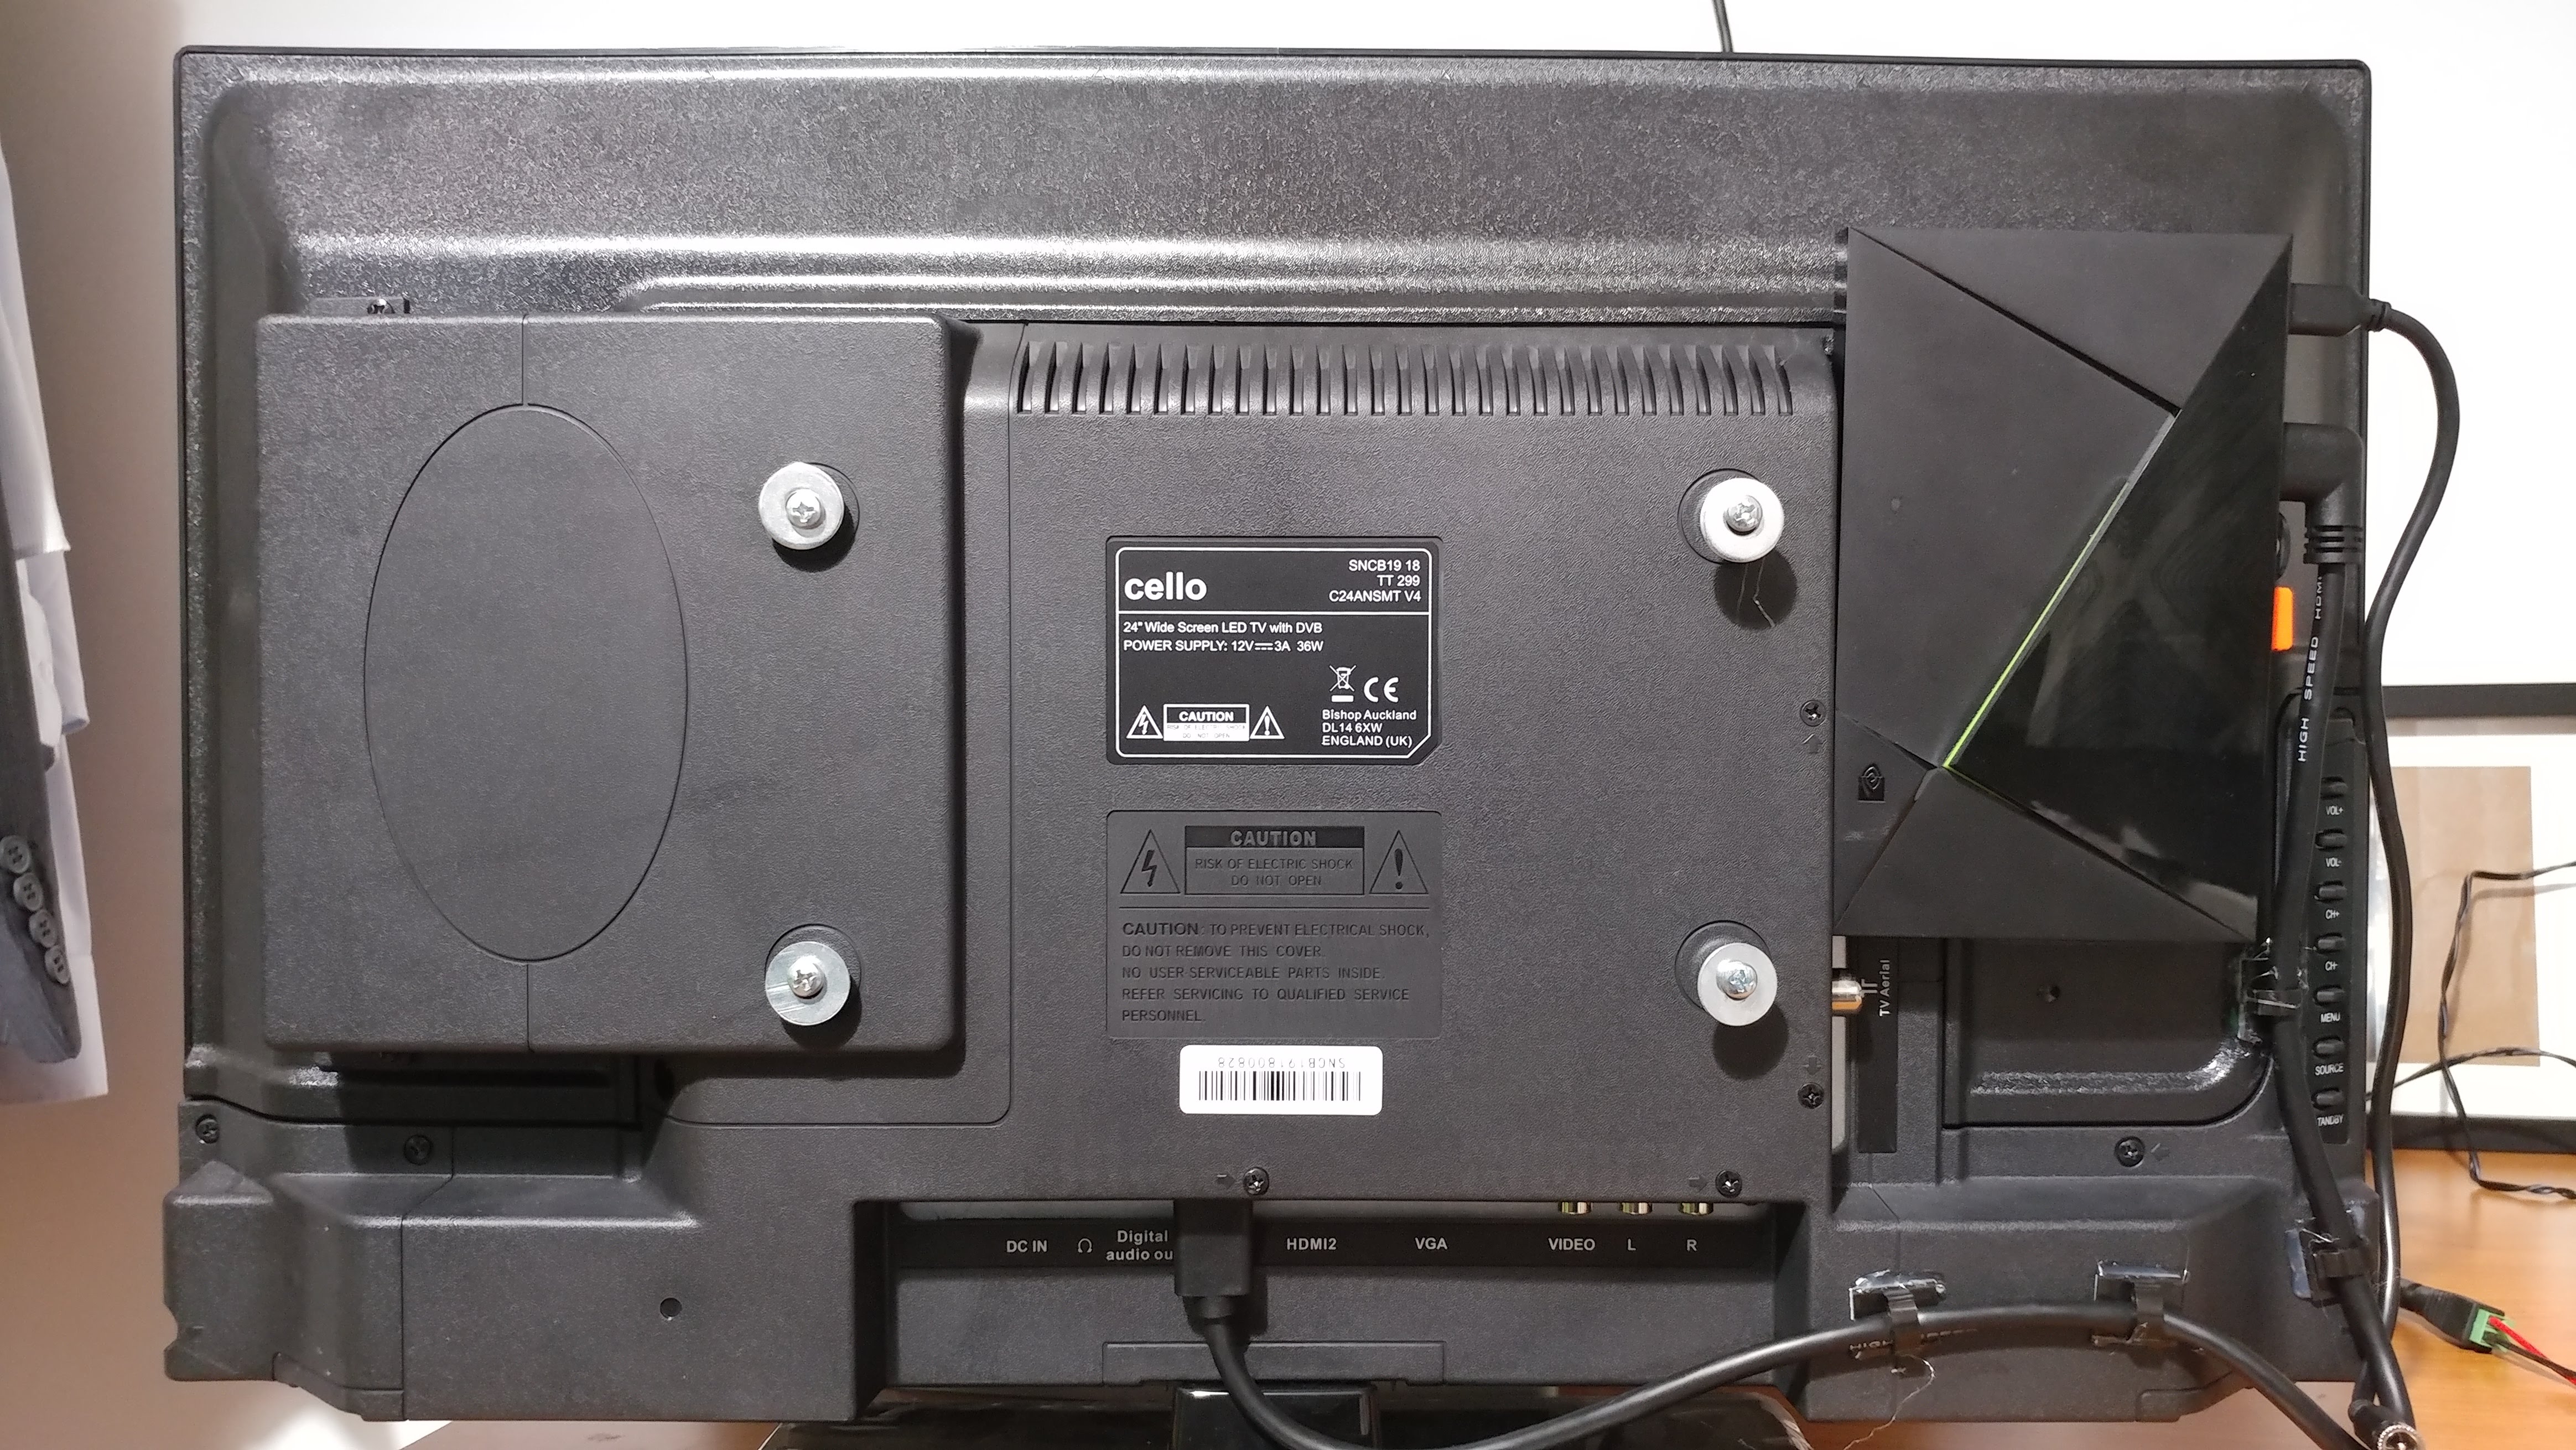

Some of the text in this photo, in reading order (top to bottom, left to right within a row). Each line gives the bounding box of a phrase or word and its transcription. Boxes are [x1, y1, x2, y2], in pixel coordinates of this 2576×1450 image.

[1348, 559, 1421, 572] SNCB19 18
[1124, 571, 1207, 600] cello
[1377, 574, 1420, 587] TT 299
[1329, 590, 1421, 602] C24ANSMT V4
[1144, 621, 1175, 633] Wide
[1177, 621, 1218, 633] Screen
[1222, 622, 1247, 633] LED
[1249, 622, 1267, 633] TV
[1269, 622, 1292, 633] with
[1296, 622, 1323, 633] DVB
[1123, 639, 1172, 651] POWER
[1175, 639, 1228, 651] SUPPLY:
[1297, 640, 1323, 651] 36W
[2298, 718, 2310, 762] HIGH
[2304, 636, 2318, 701] SPEED
[1178, 711, 1234, 722] CAUTION
[1322, 709, 1417, 722] Bishop Auckland
[1322, 722, 1383, 733] DL14 6XW
[1321, 736, 1412, 748] ENGLAND (UK)
[2325, 805, 2343, 815] VOL+
[1230, 830, 1316, 847] CAUTION
[1195, 858, 1353, 869] RISK OF ELECTRIC SHOCK
[1232, 875, 1322, 886] DO NOT OPEN
[1209, 924, 1227, 936] TO
[1231, 924, 1290, 936] PREVENT
[1295, 924, 1375, 936] ELECTRICAL
[1379, 924, 1430, 939] SHOCK,
[1123, 945, 1141, 958] DO
[1145, 945, 1172, 958] NOT
[1176, 945, 1232, 958] REMOVE
[1239, 945, 1268, 957] THIS
[1123, 967, 1141, 980] NO
[1288, 967, 1329, 980] PARTS
[1123, 988, 1410, 1001] REFER SERVICING TO QUALIFIED SERVICE
[1879, 959, 1891, 1017] TV Aerial
[2321, 1013, 2341, 1023] MENU
[2315, 1063, 2344, 1075] SOURCE
[2317, 1114, 2344, 1127] TANDBY
[1117, 1230, 1168, 1245] Digital
[1286, 1237, 1337, 1251] HDMI2
[1415, 1237, 1448, 1251] VGA
[1006, 1240, 1047, 1254] DC IN
[1548, 1238, 1596, 1252] VIDEO
[1628, 1239, 1637, 1252] L
[1686, 1240, 1697, 1252] R
[1106, 1249, 1173, 1262] audio ou
